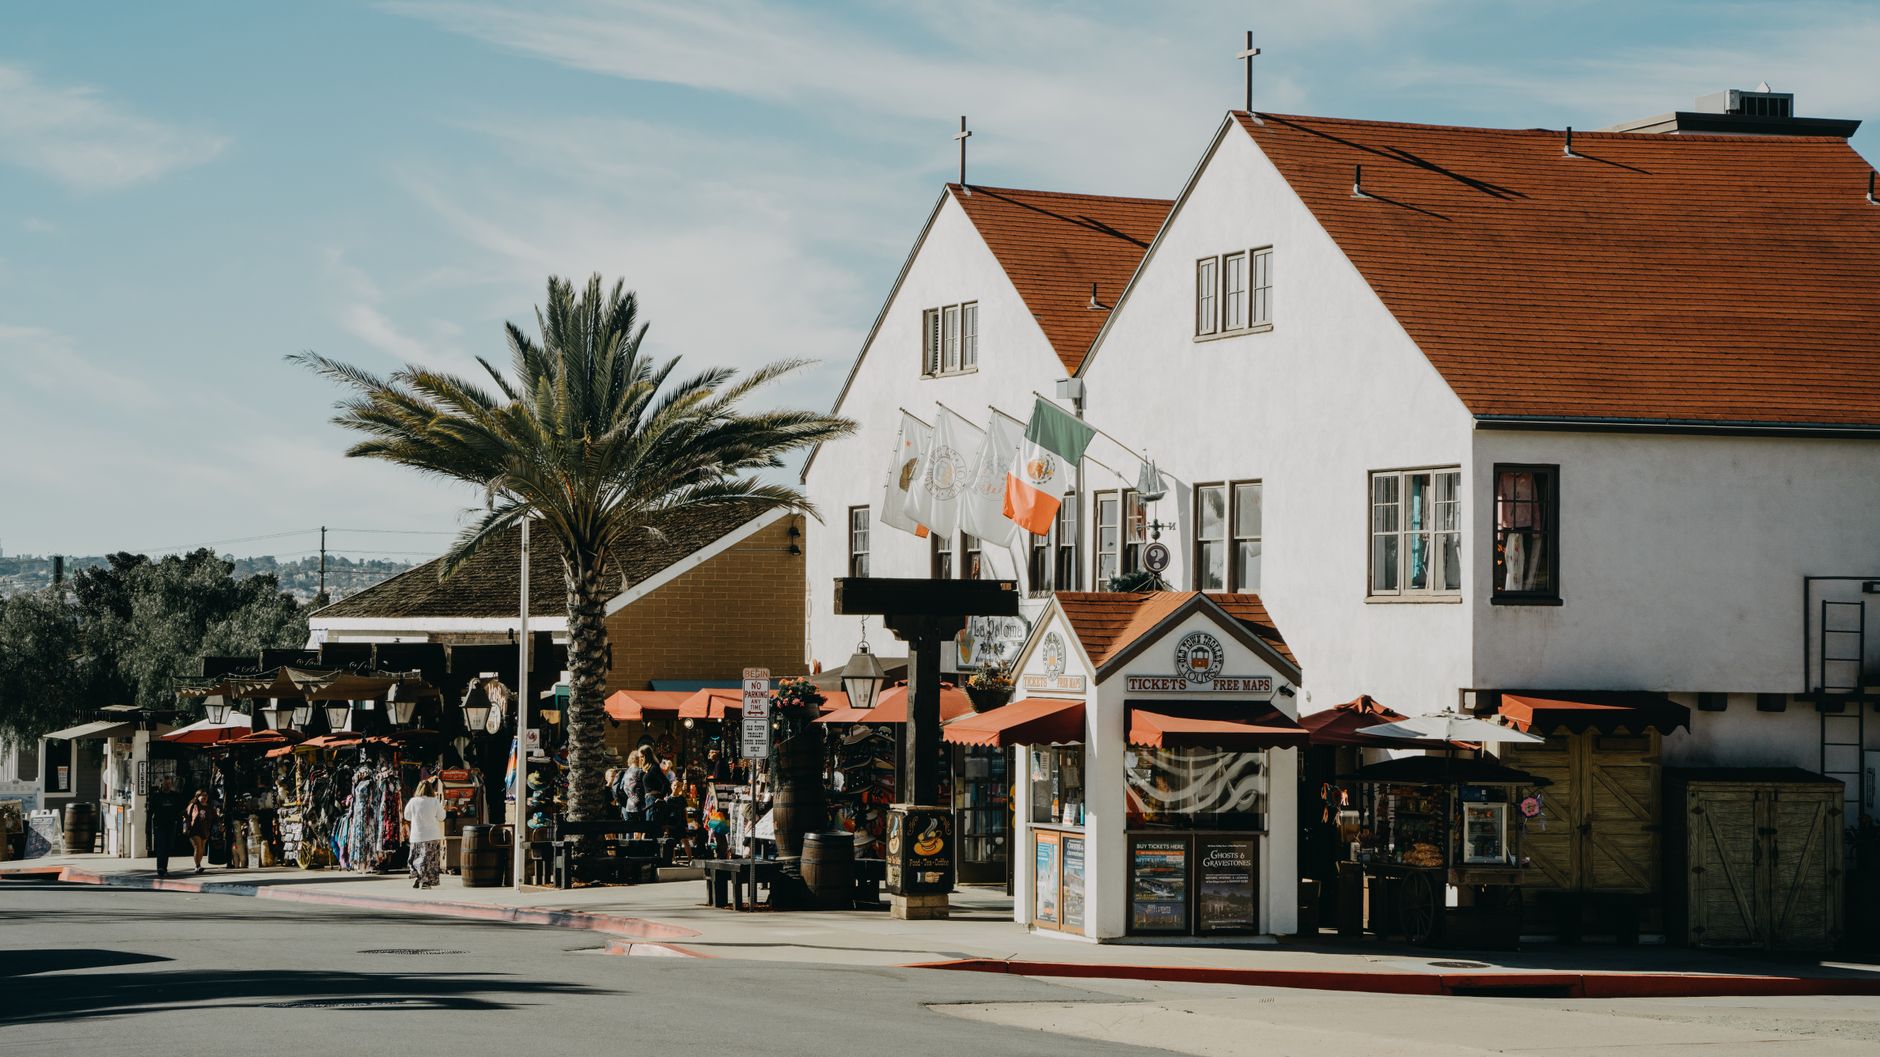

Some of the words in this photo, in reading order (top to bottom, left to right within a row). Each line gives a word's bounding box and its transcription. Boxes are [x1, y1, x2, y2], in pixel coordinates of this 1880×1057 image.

[974, 620, 985, 638] La
[986, 620, 1023, 638] Paloma
[1182, 634, 1201, 649] TOWN
[1178, 649, 1187, 663] OLD
[1203, 635, 1222, 664] TROLLEY
[744, 670, 768, 678] BEGIN
[1183, 665, 1217, 683] TOURS
[751, 682, 761, 690] NO
[1128, 678, 1187, 691] TICKETS
[1213, 679, 1240, 691] FREE
[1242, 679, 1270, 691] MAPS
[744, 690, 768, 698] PARKING
